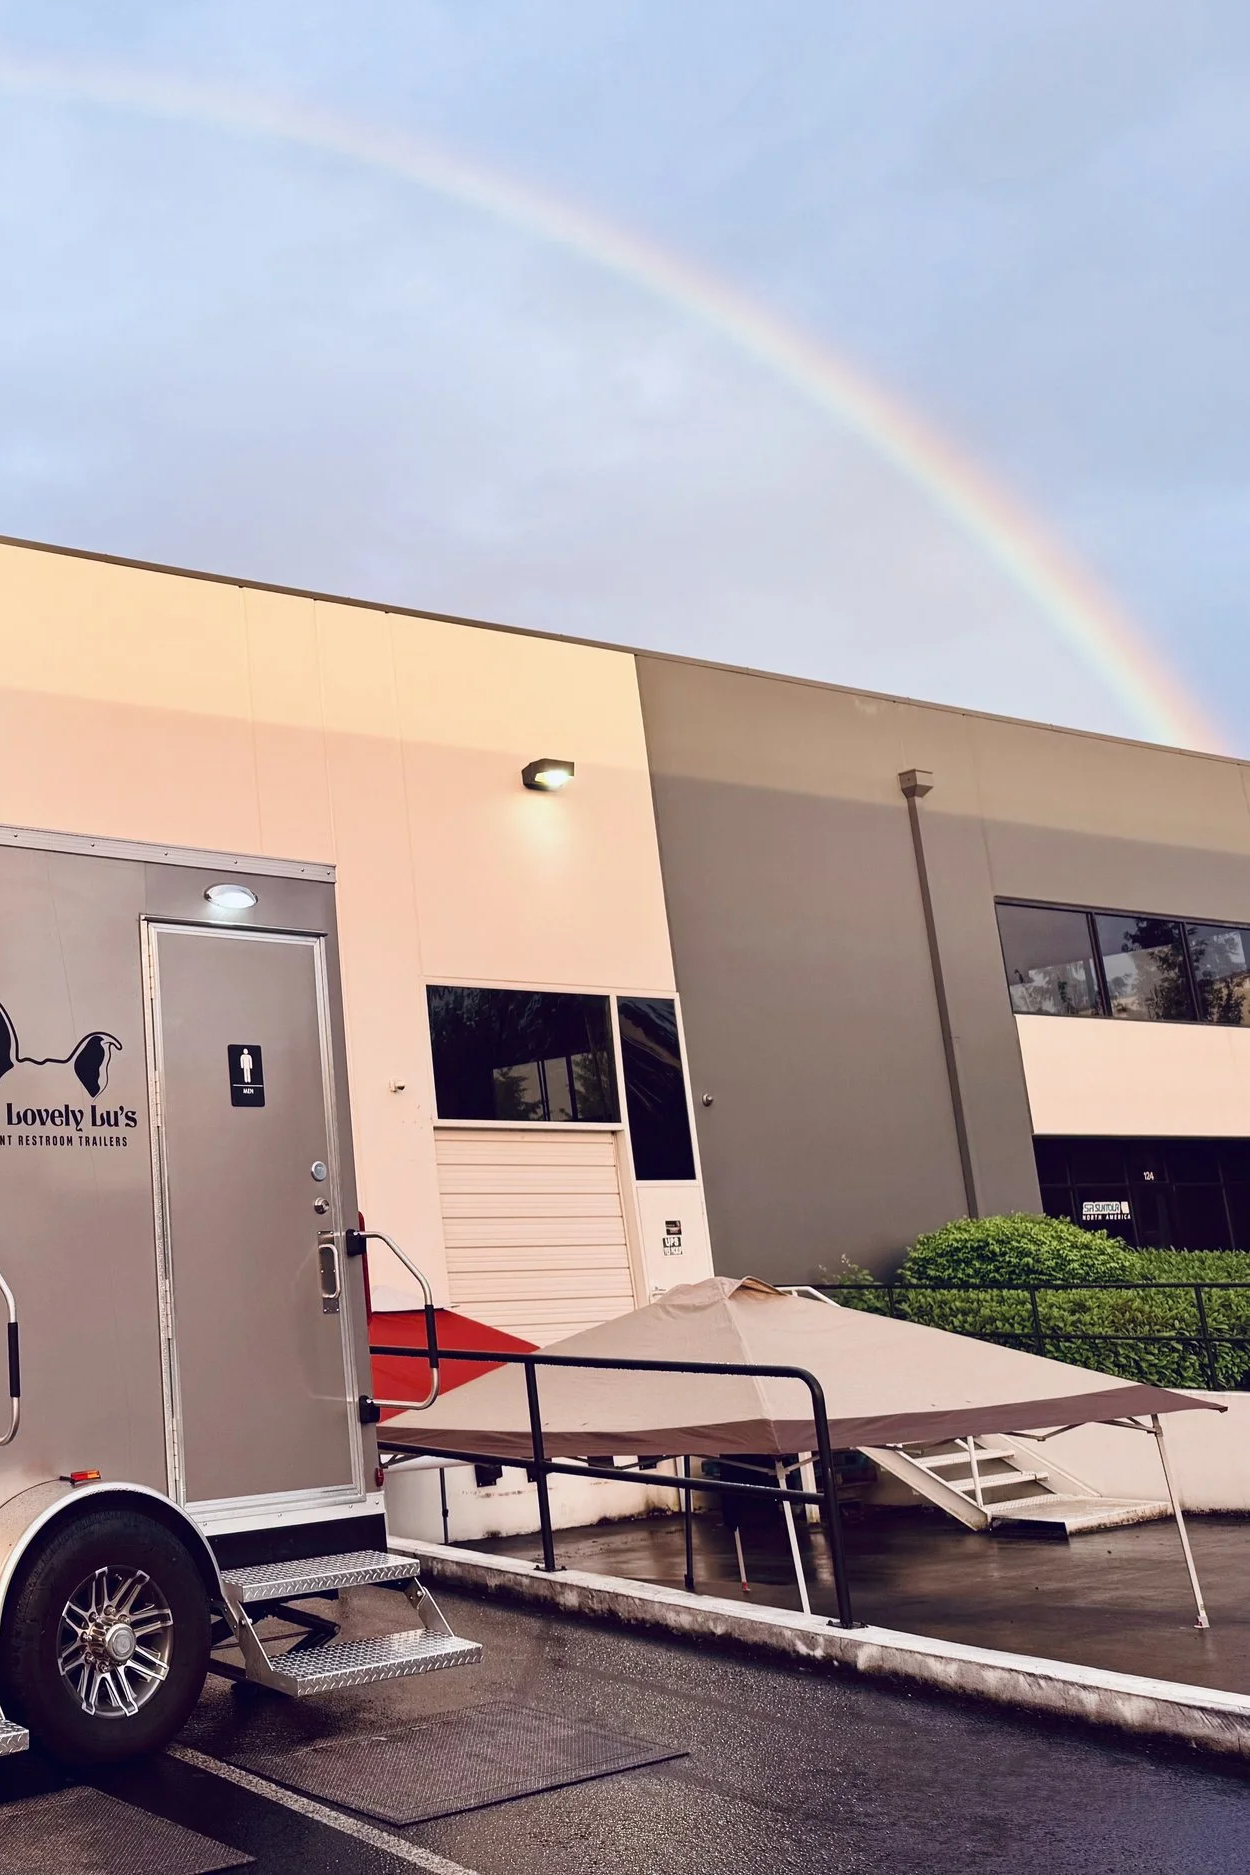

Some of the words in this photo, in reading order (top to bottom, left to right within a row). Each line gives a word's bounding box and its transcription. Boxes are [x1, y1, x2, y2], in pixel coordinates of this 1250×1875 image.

[6, 1102, 84, 1132] Lovely
[90, 1104, 138, 1128] Lu's
[18, 1135, 73, 1147] RESTROOM
[78, 1136, 128, 1147] TRAILERS
[1143, 1171, 1155, 1181] 124
